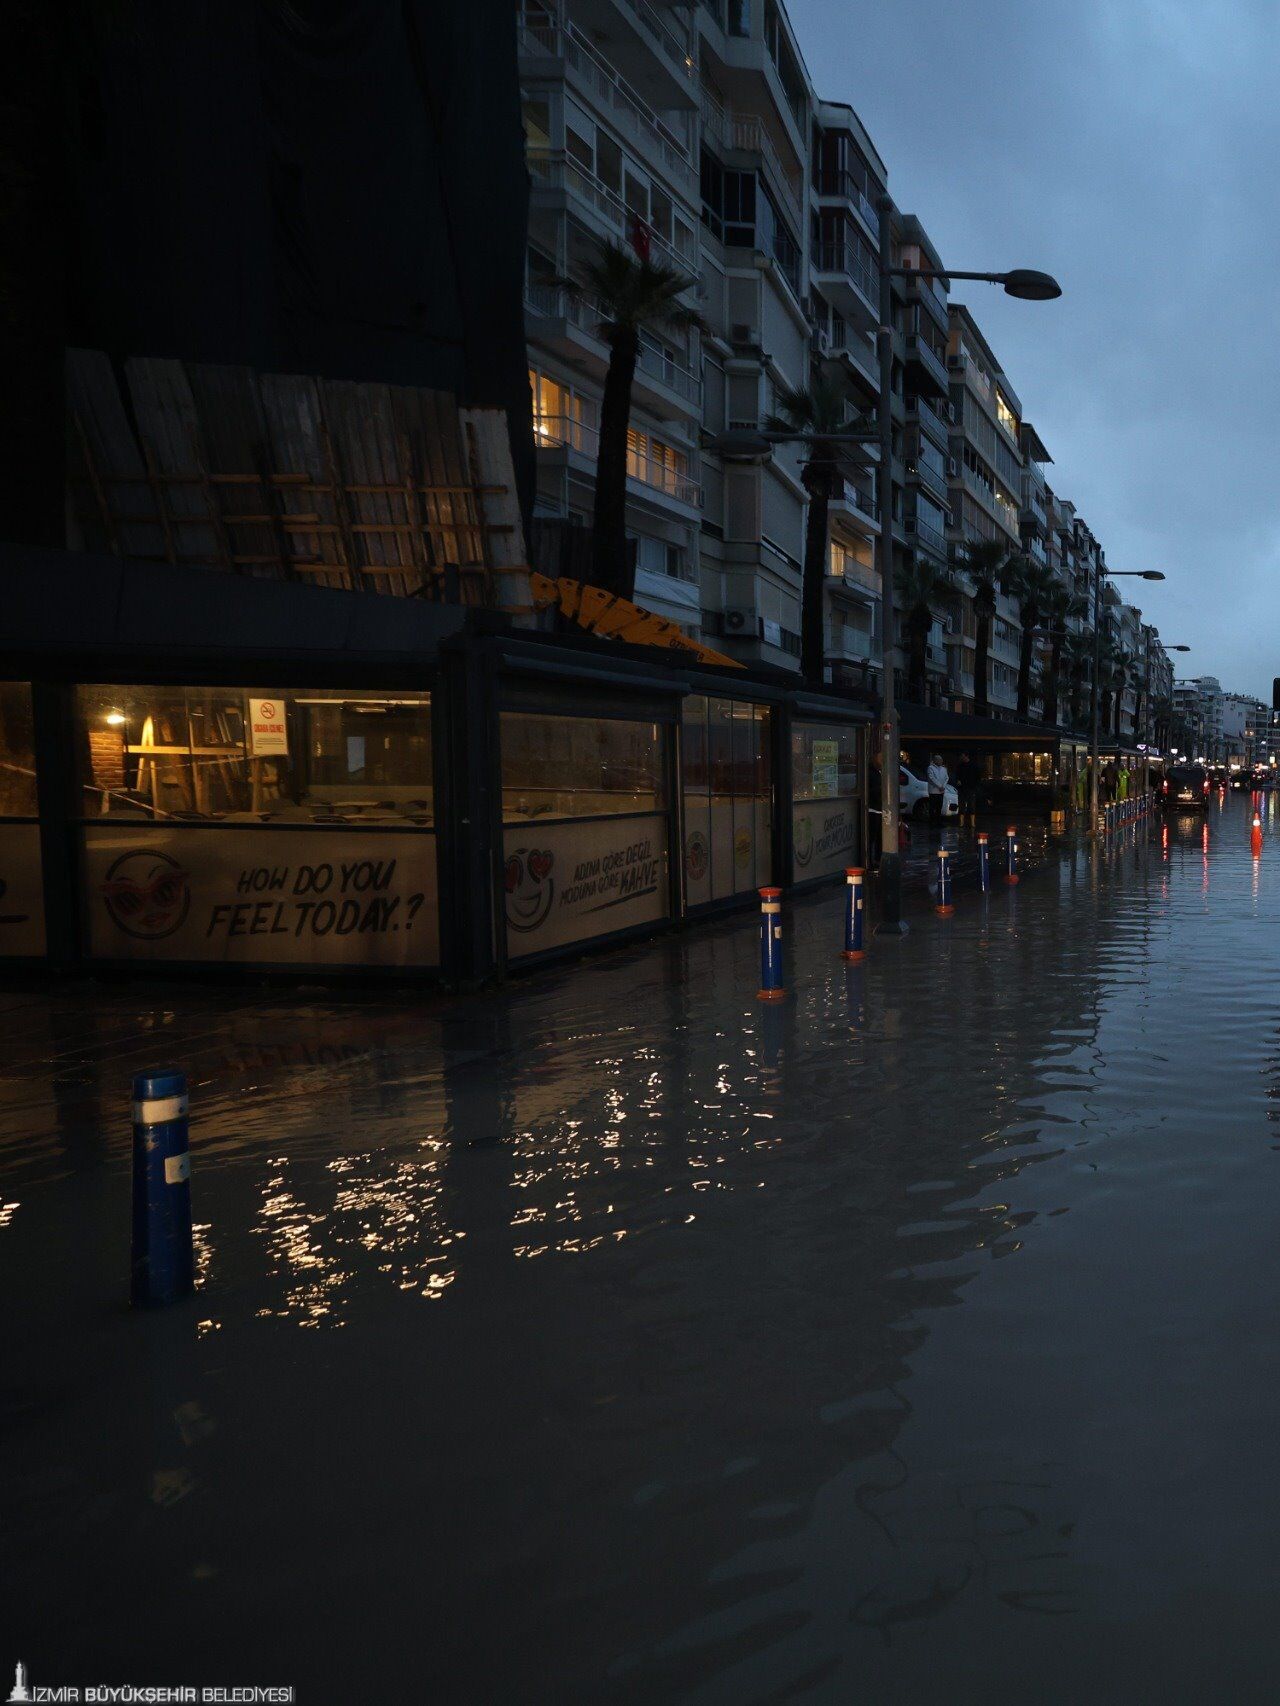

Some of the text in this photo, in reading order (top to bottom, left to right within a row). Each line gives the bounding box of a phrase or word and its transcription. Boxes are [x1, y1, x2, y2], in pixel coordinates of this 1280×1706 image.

[236, 858, 397, 895] HOW DO YOU
[573, 858, 600, 882] ADINA
[619, 859, 659, 895] KAHVE
[206, 901, 289, 938] FEEL
